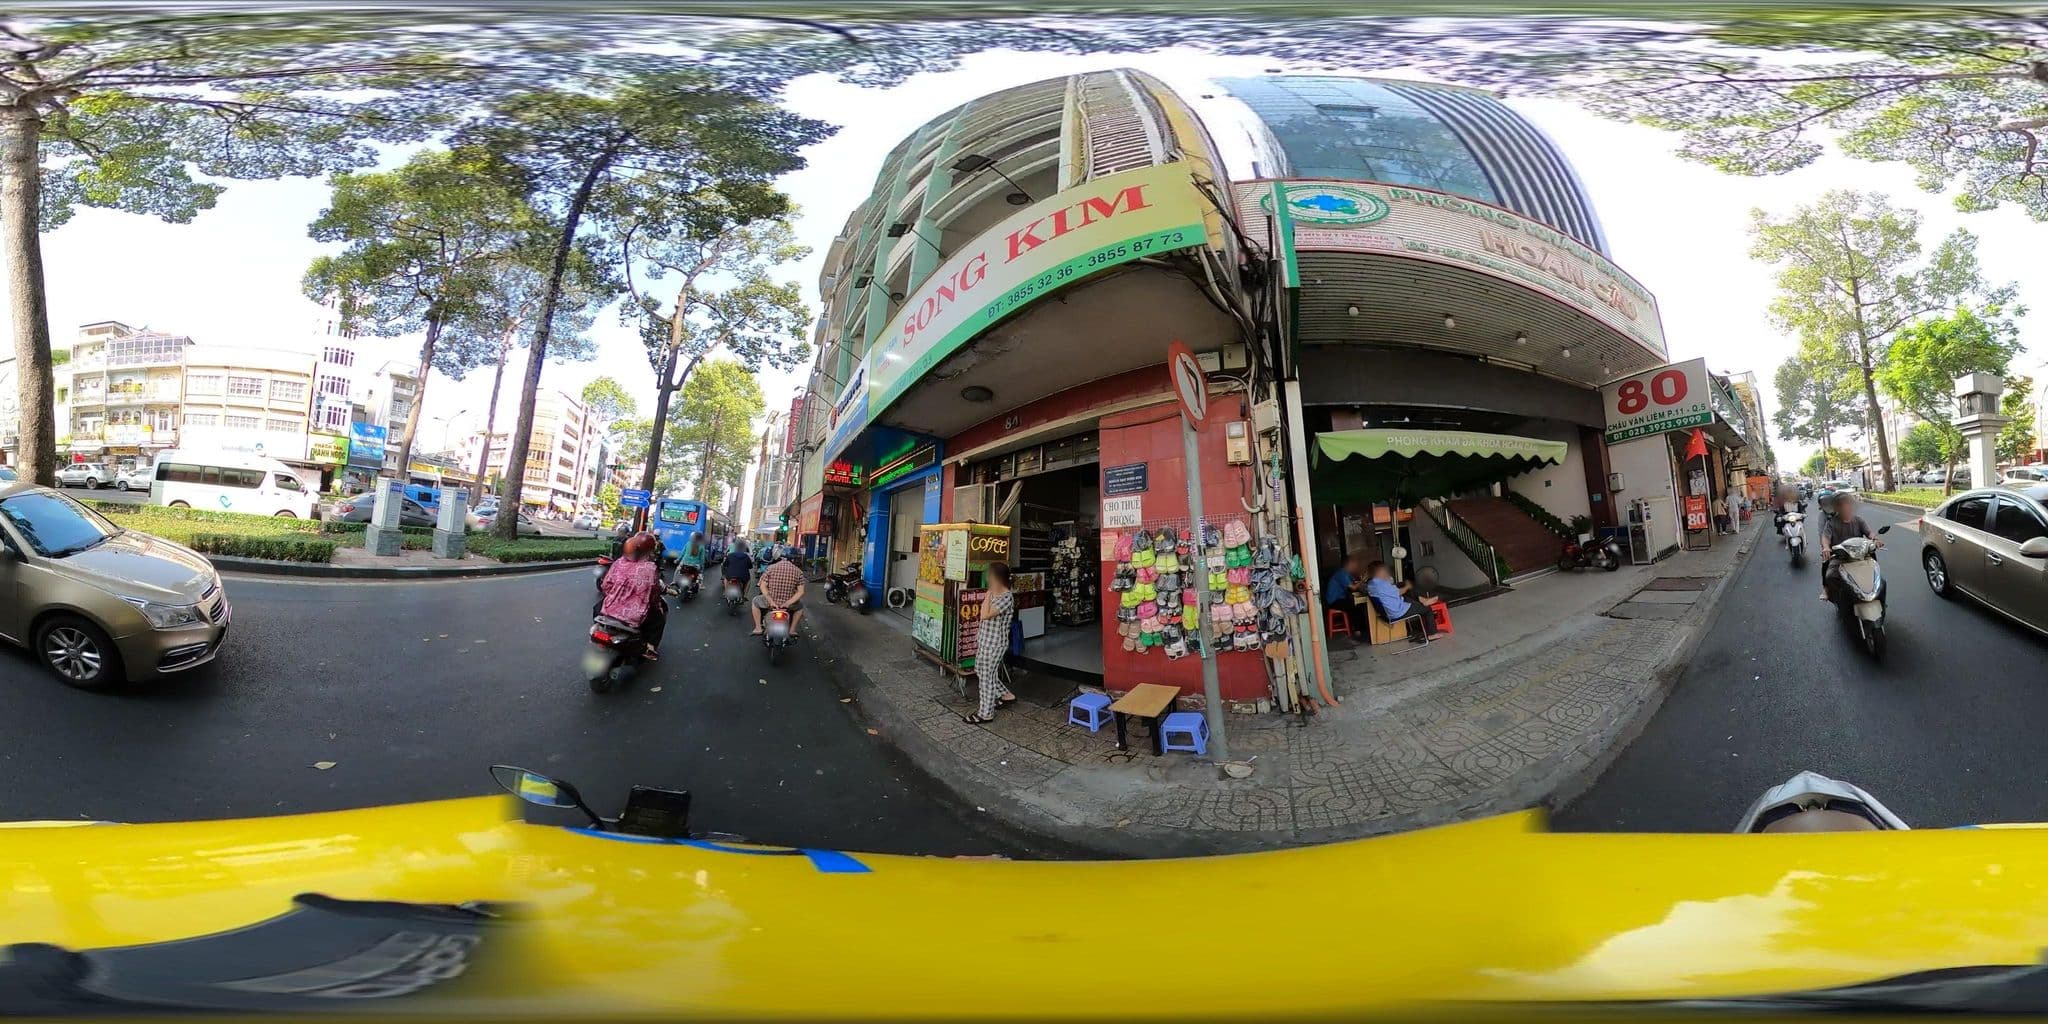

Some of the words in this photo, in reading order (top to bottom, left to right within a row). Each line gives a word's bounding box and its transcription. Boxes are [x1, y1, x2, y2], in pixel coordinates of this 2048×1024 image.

[902, 250, 990, 348] SONG
[1003, 183, 1153, 264] KIM
[1007, 284, 1034, 307] 3855
[1037, 274, 1053, 293] 32
[1056, 264, 1074, 280] 36
[1087, 246, 1127, 269] 3855
[1133, 238, 1154, 251] 87
[1160, 231, 1185, 246] 73
[1617, 369, 1689, 415] 80
[1692, 403, 1707, 413] Q.5
[1687, 512, 1707, 526] 80
